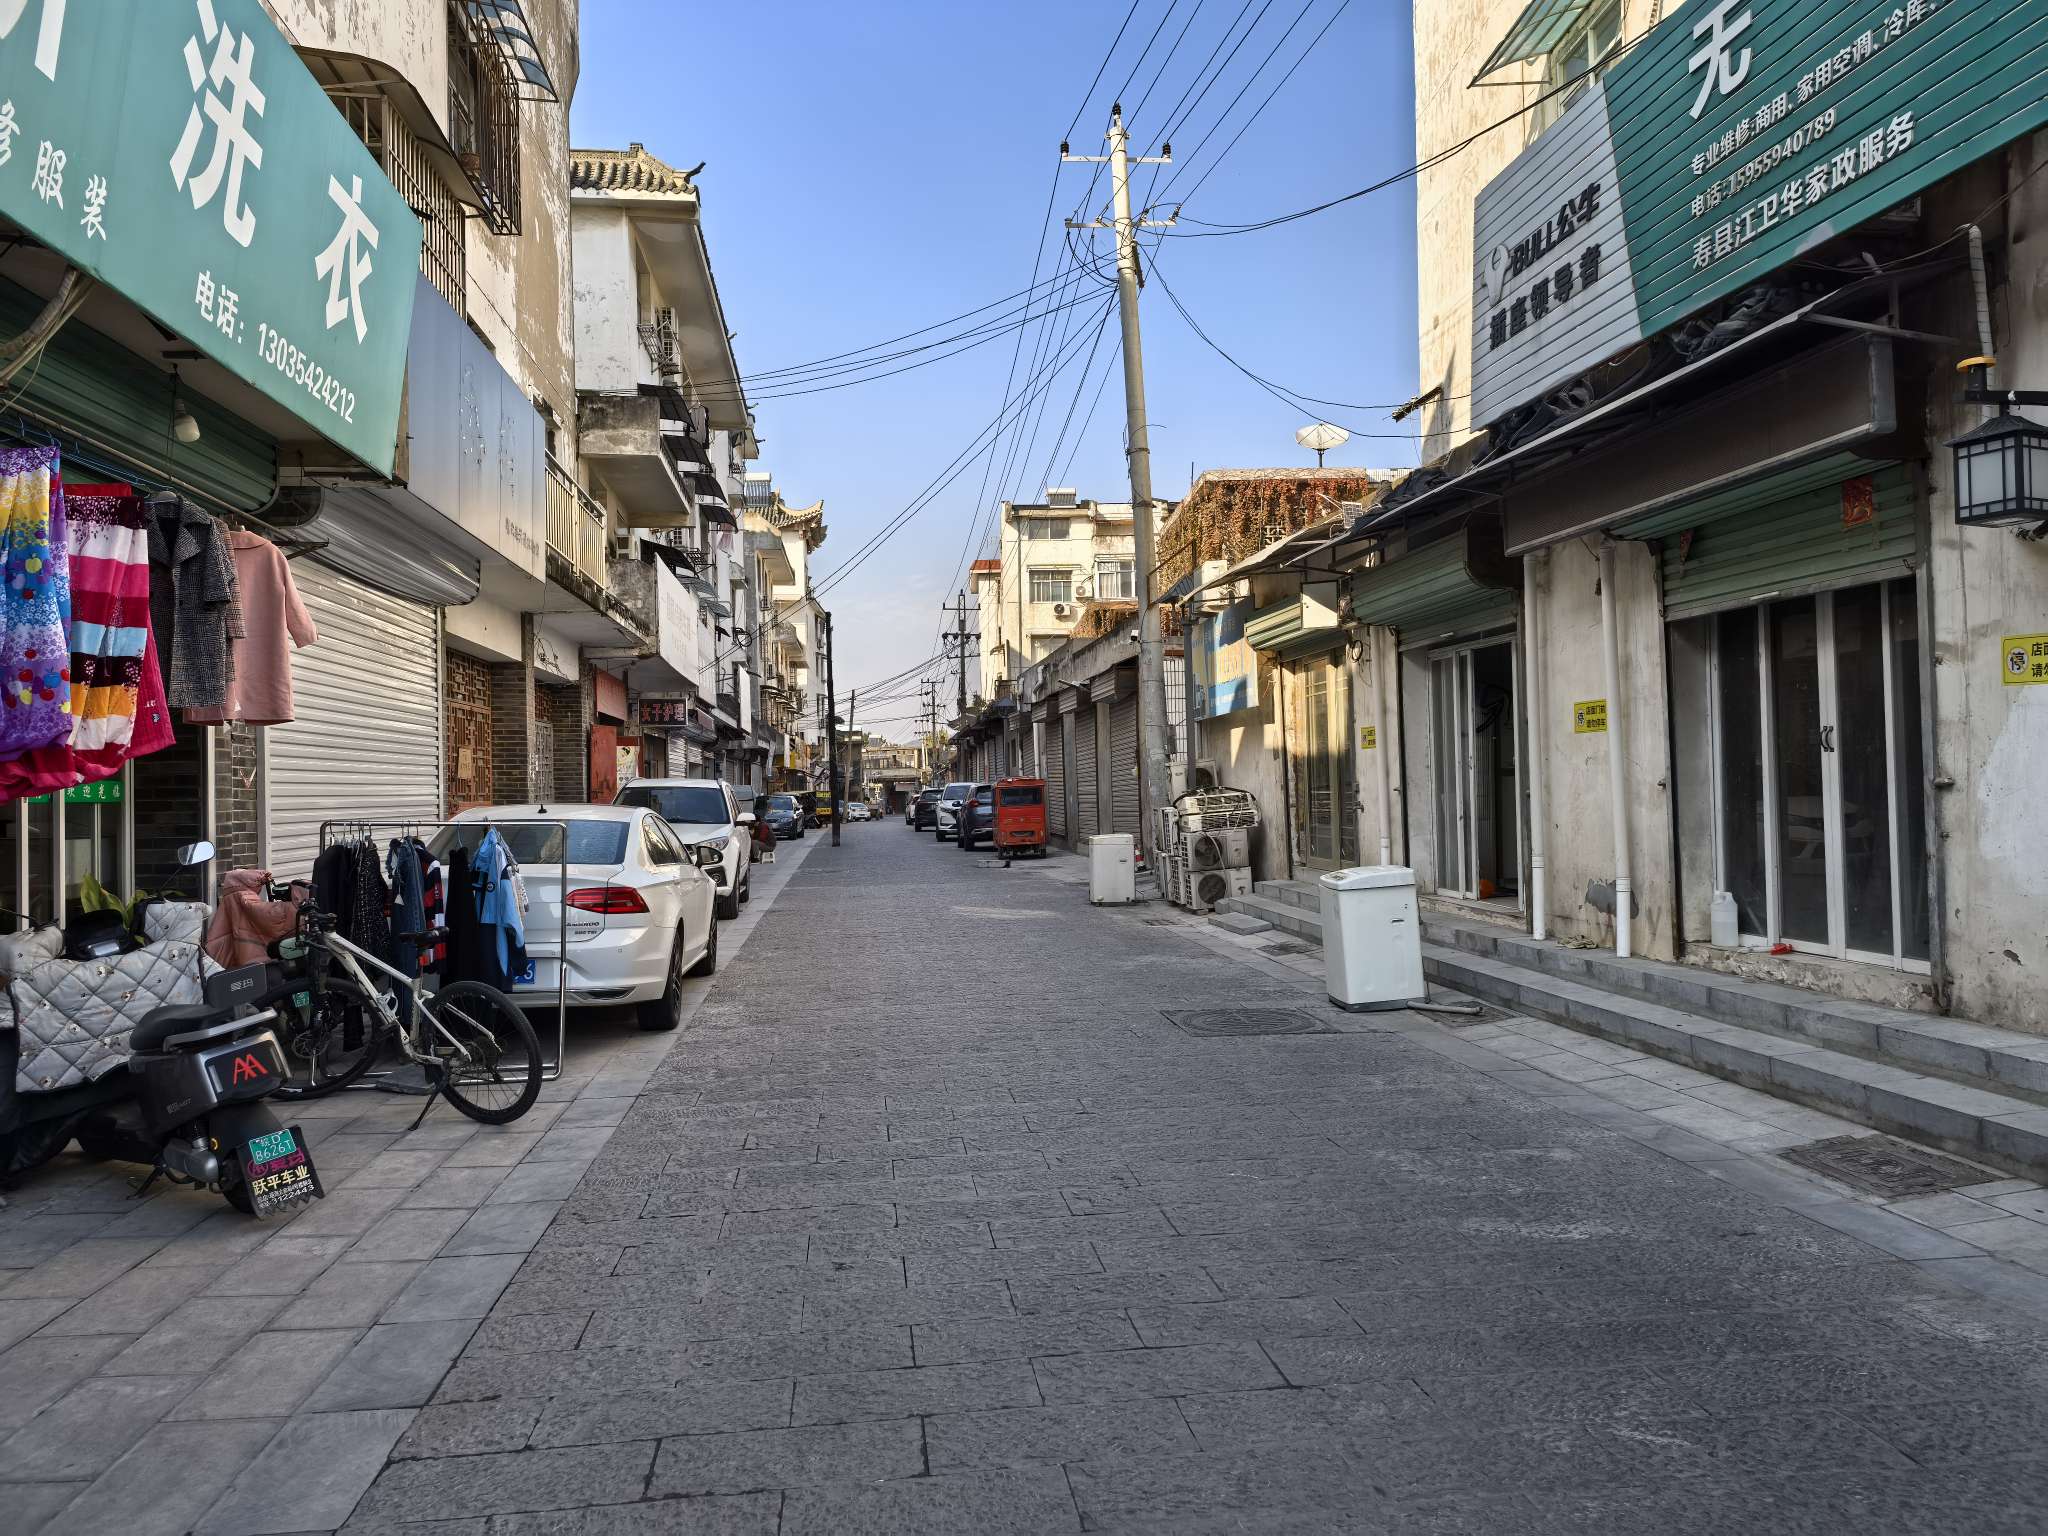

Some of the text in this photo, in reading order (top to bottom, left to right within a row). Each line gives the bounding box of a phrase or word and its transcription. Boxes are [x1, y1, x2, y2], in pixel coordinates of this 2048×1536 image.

[1688, 0, 1752, 119] 无
[1692, 110, 1916, 270] 寿县江卫华家政服务
[1489, 243, 1602, 351] 插座领导者
[252, 1165, 311, 1196] 跃平车业
